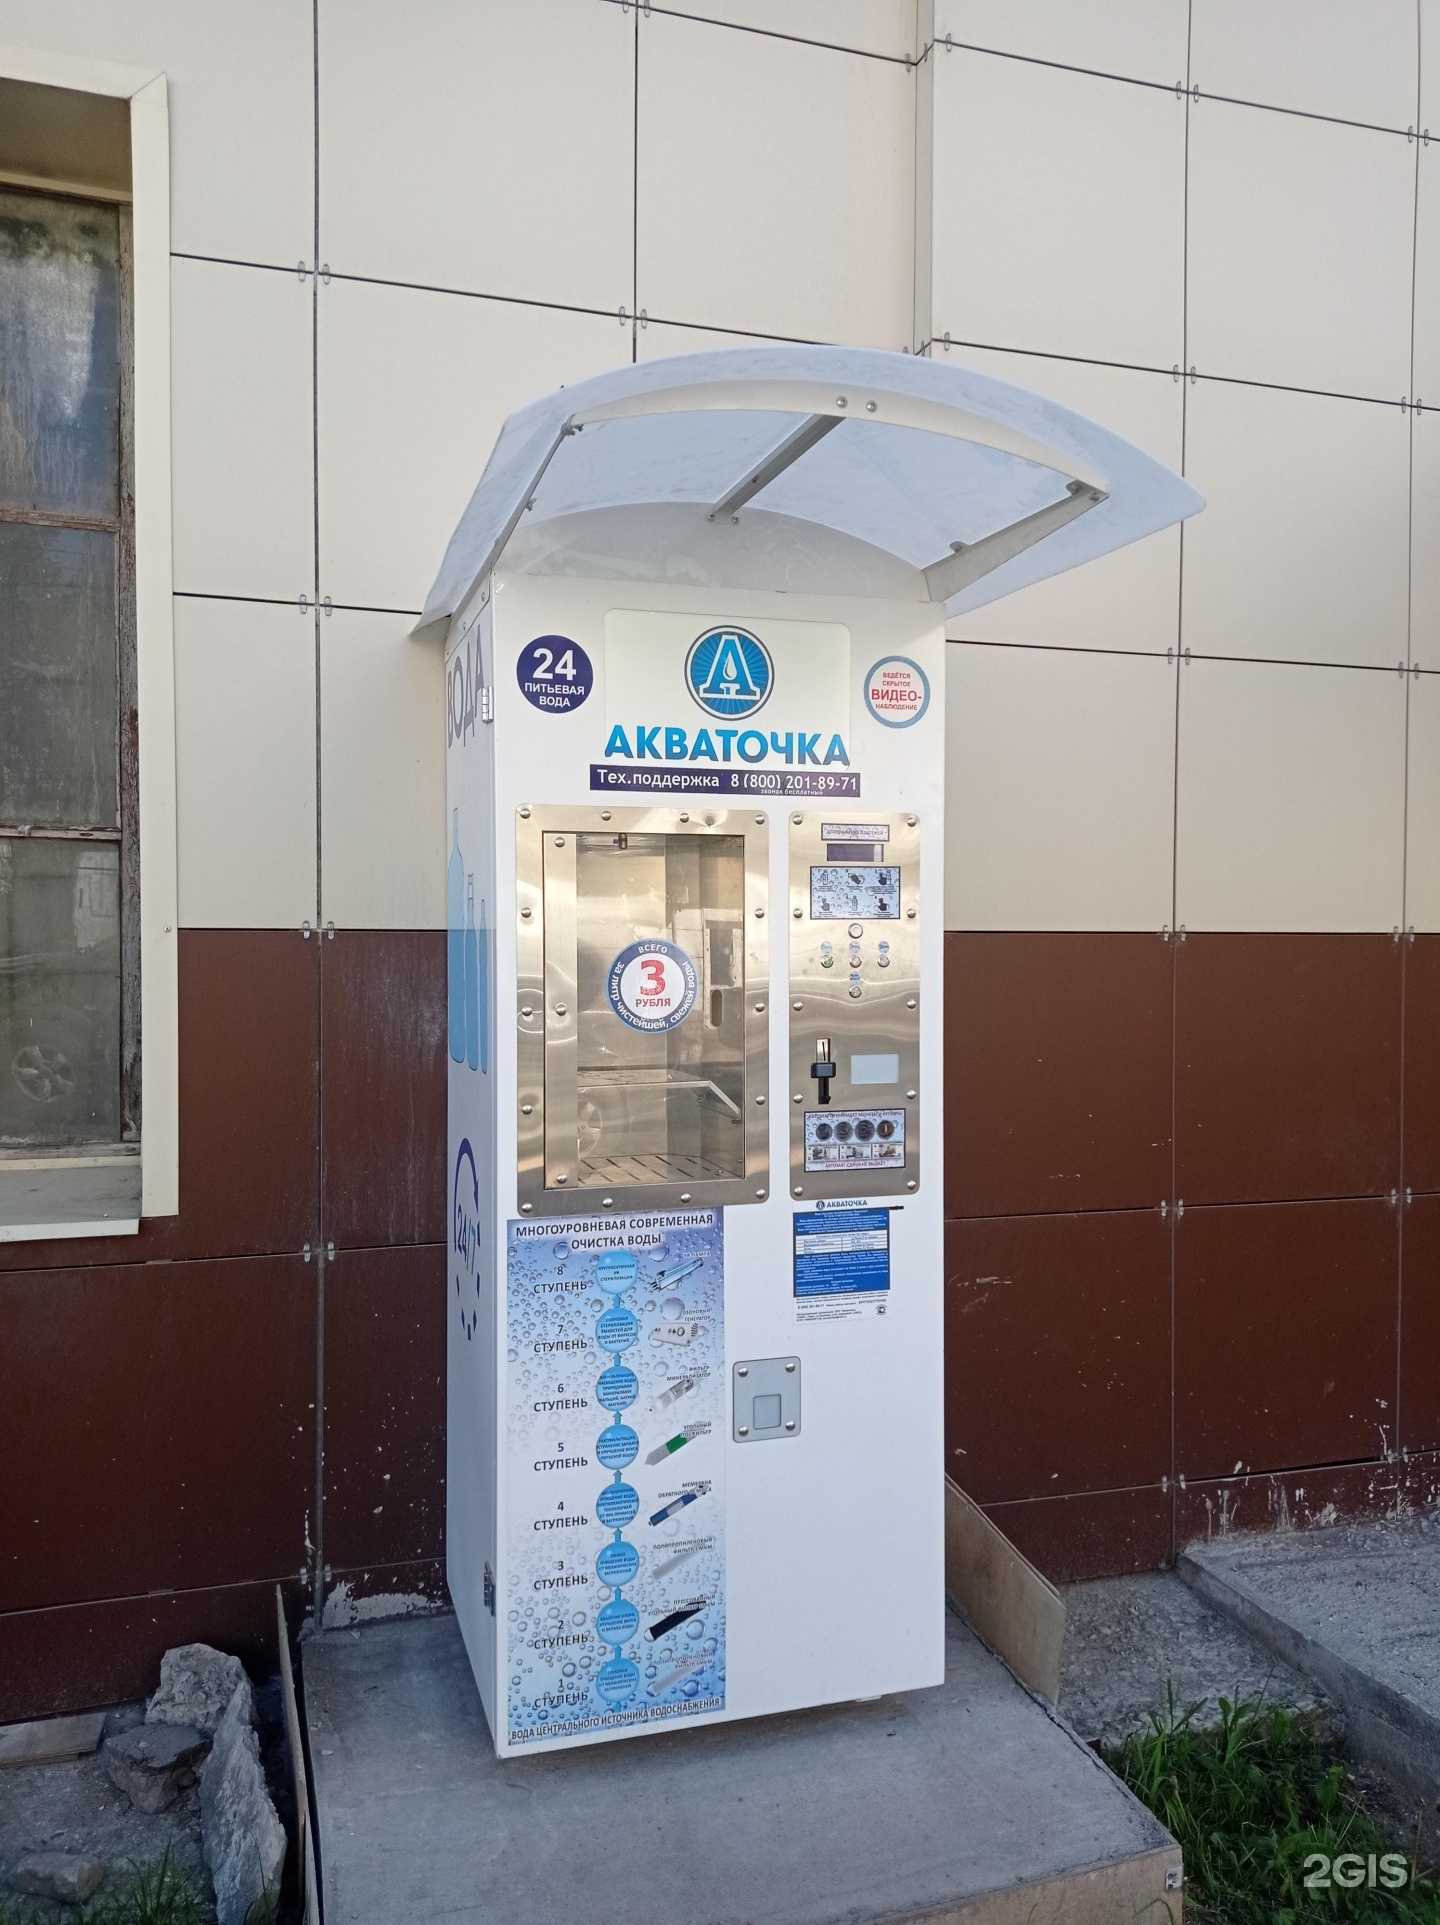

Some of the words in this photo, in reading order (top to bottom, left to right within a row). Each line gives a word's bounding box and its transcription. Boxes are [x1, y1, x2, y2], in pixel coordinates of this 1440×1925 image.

[532, 648, 576, 680] 24
[524, 682, 584, 695] ПИТЬЕВАЯ
[872, 688, 922, 702] ВИДЕО-
[539, 696, 570, 708] ВОДА
[604, 724, 850, 766] АКВАТОЧКА
[597, 769, 720, 789] Тех.поддержка
[730, 773, 739, 787] 8
[744, 774, 782, 789] (800)
[786, 776, 857, 790] 201-89-71
[638, 943, 668, 954] ВСЕГО
[640, 960, 666, 996] 3
[636, 998, 672, 1008] РУБЛЯ
[826, 1200, 868, 1208] АКВАТОЧКА
[516, 1220, 626, 1237] МНОГОУРОВНЕВАЯ
[630, 1214, 713, 1230] СОВРЕМЕННАЯ
[458, 1204, 476, 1275] 24/7
[572, 1237, 624, 1250] ОЧИСТКА
[628, 1234, 662, 1246] ВОДЫ
[557, 1266, 564, 1275] 8
[534, 1281, 588, 1294] СТУПЕНЬ
[558, 1325, 564, 1334] 7
[534, 1340, 588, 1353] СТУПЕНЬ
[558, 1384, 564, 1392] 6
[534, 1400, 588, 1412] СТУПЕНЬ
[558, 1443, 564, 1452] 5
[534, 1458, 588, 1472] СТУПЕНЬ
[558, 1502, 564, 1511] 4
[534, 1516, 588, 1530] СТУПЕНЬ
[558, 1560, 564, 1570] 3
[534, 1576, 588, 1590] СТУПЕНЬ
[558, 1620, 564, 1630] 2
[534, 1636, 588, 1650] СТУПЕНЬ
[534, 1692, 588, 1708] СТУПЕНЬ
[511, 1729, 535, 1740] ВОДА
[536, 1717, 600, 1737] ЦЕНТРАЛЬНОГО
[601, 1710, 649, 1728] ИСТОЧНИКА
[650, 1698, 720, 1716] ВОДОСНАБЖЕНИЯ
